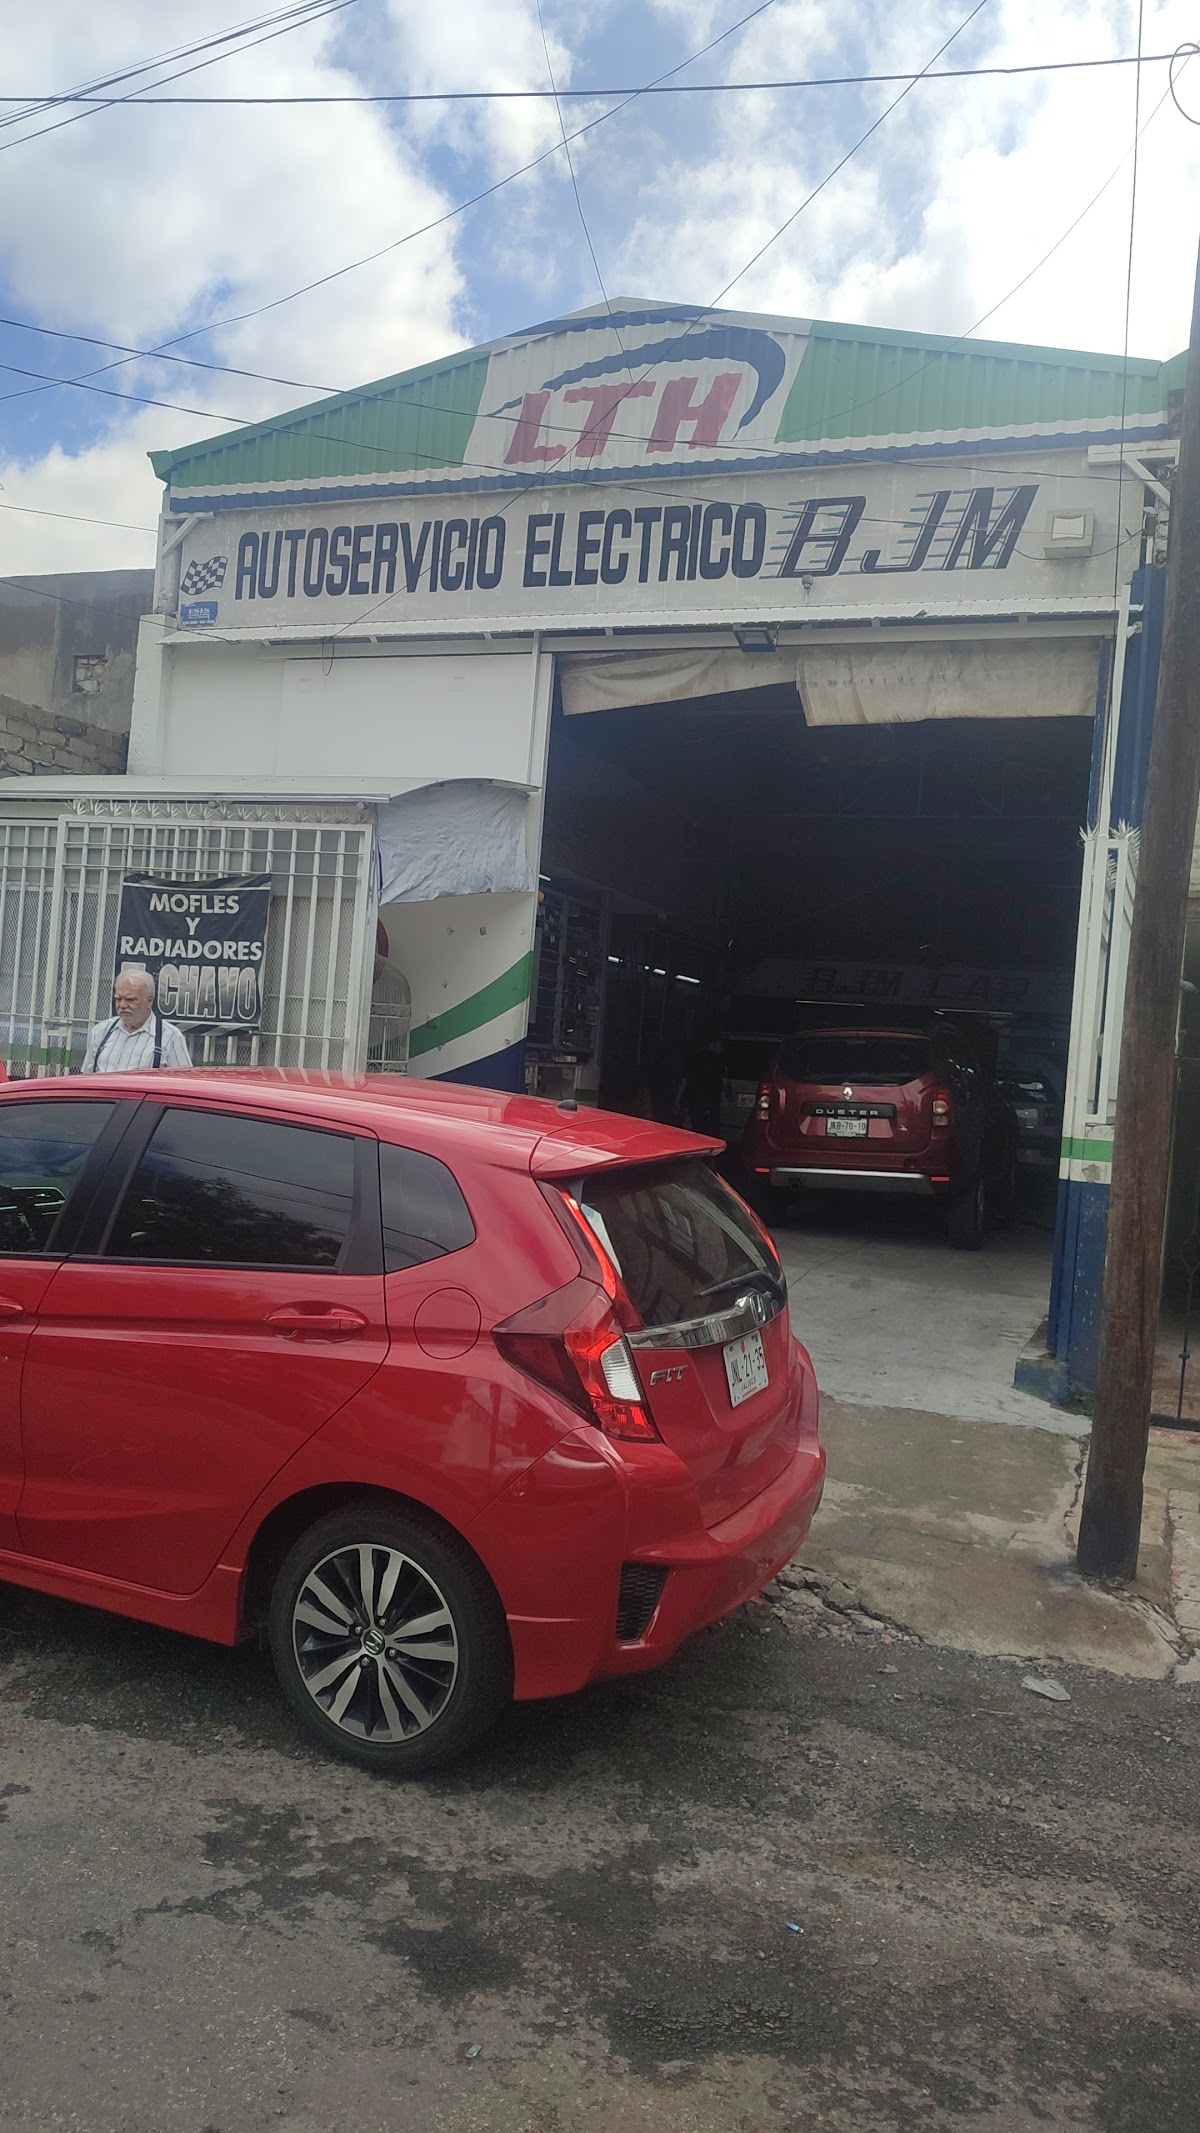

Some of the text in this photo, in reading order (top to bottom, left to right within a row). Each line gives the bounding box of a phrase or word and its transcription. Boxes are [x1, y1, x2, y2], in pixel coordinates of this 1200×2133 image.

[503, 372, 745, 465] LTH
[235, 484, 1040, 601] AUTOSERVICIO ELECTRICO BJM
[149, 892, 240, 914] MOFLES
[185, 917, 201, 935] Y
[120, 936, 263, 961] RADIADORES
[157, 963, 257, 1020] CHAVO
[815, 1108, 879, 1116] DUSTER
[650, 1365, 689, 1386] FIT
